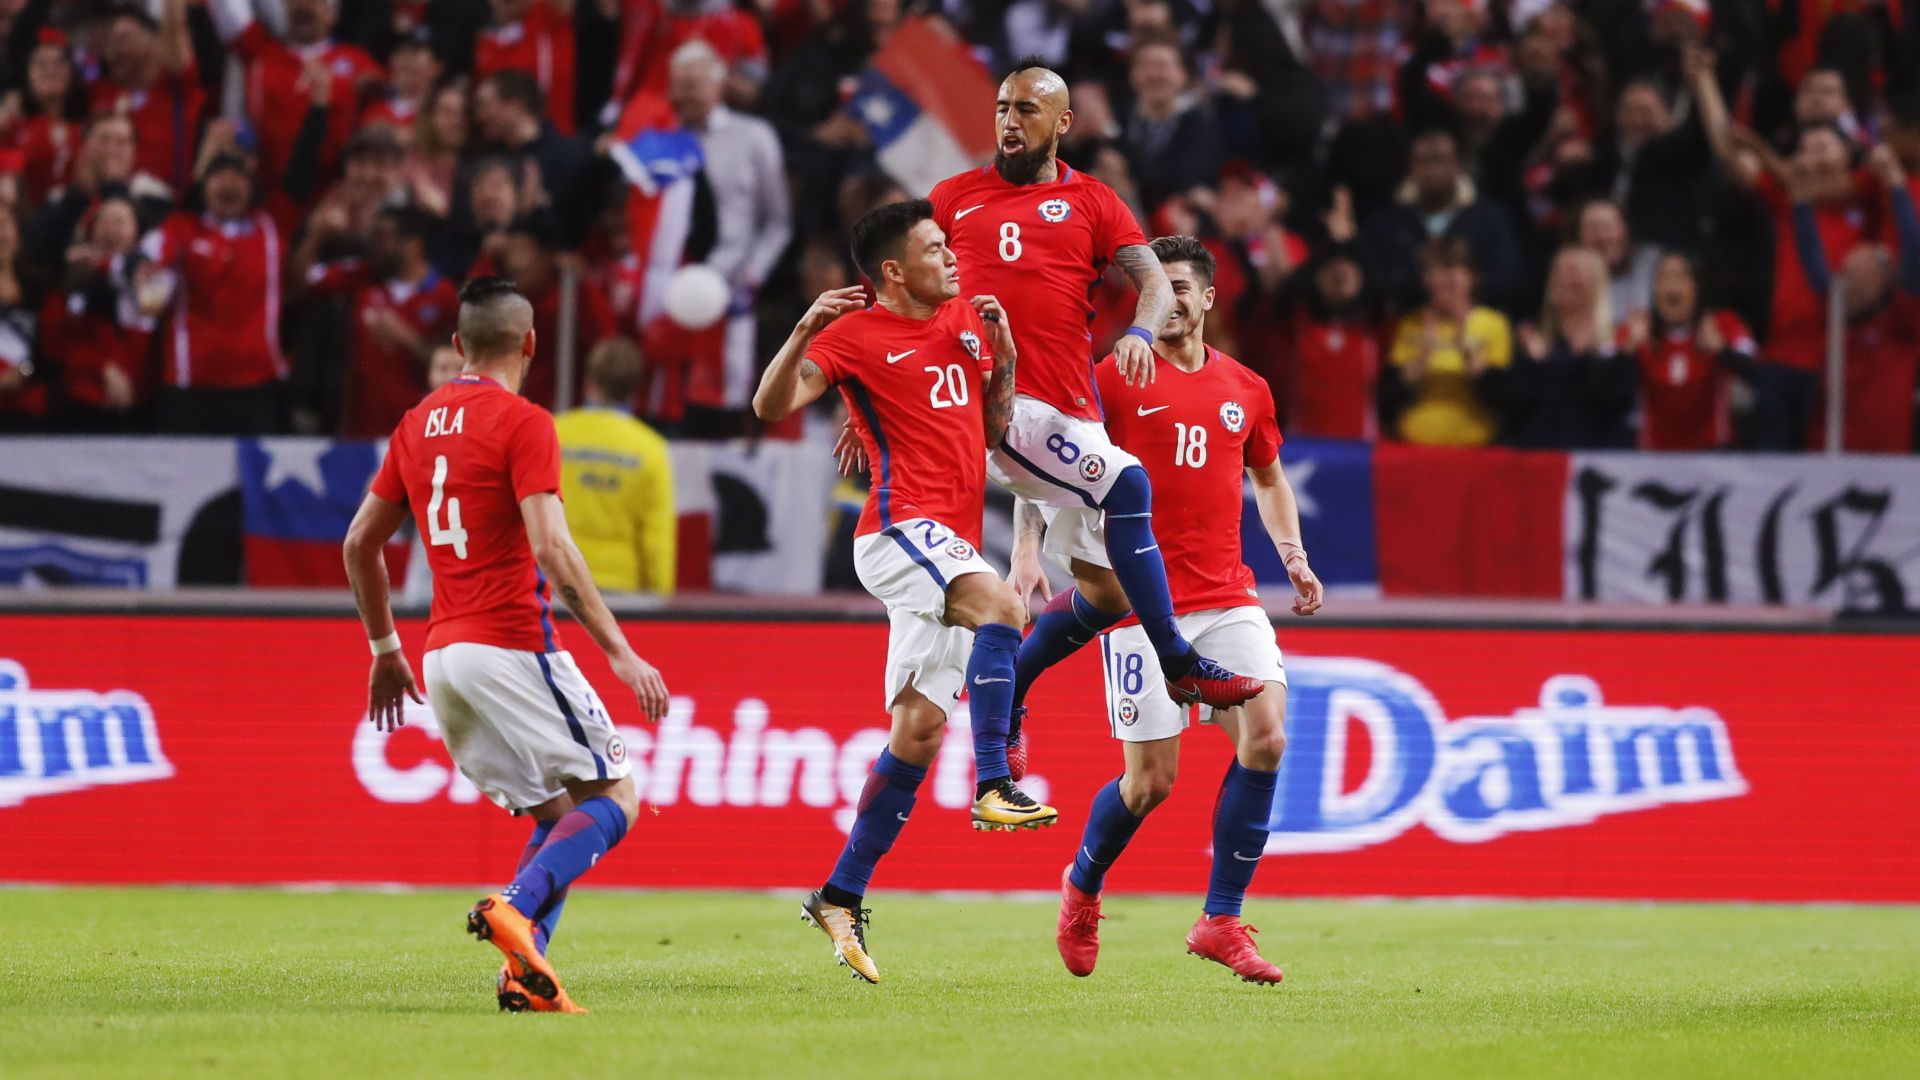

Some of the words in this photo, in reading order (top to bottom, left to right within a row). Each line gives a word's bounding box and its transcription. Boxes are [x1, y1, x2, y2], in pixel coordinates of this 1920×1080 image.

[998, 221, 1023, 262] 8
[923, 363, 969, 409] 20
[424, 406, 465, 438] ISLA
[1046, 433, 1080, 465] 8
[1174, 422, 1208, 469] 18
[427, 454, 469, 560] 4
[913, 519, 949, 550] 2
[1114, 652, 1143, 695] 18
[352, 695, 892, 838] Cshing
[1265, 656, 1748, 852] Daim
